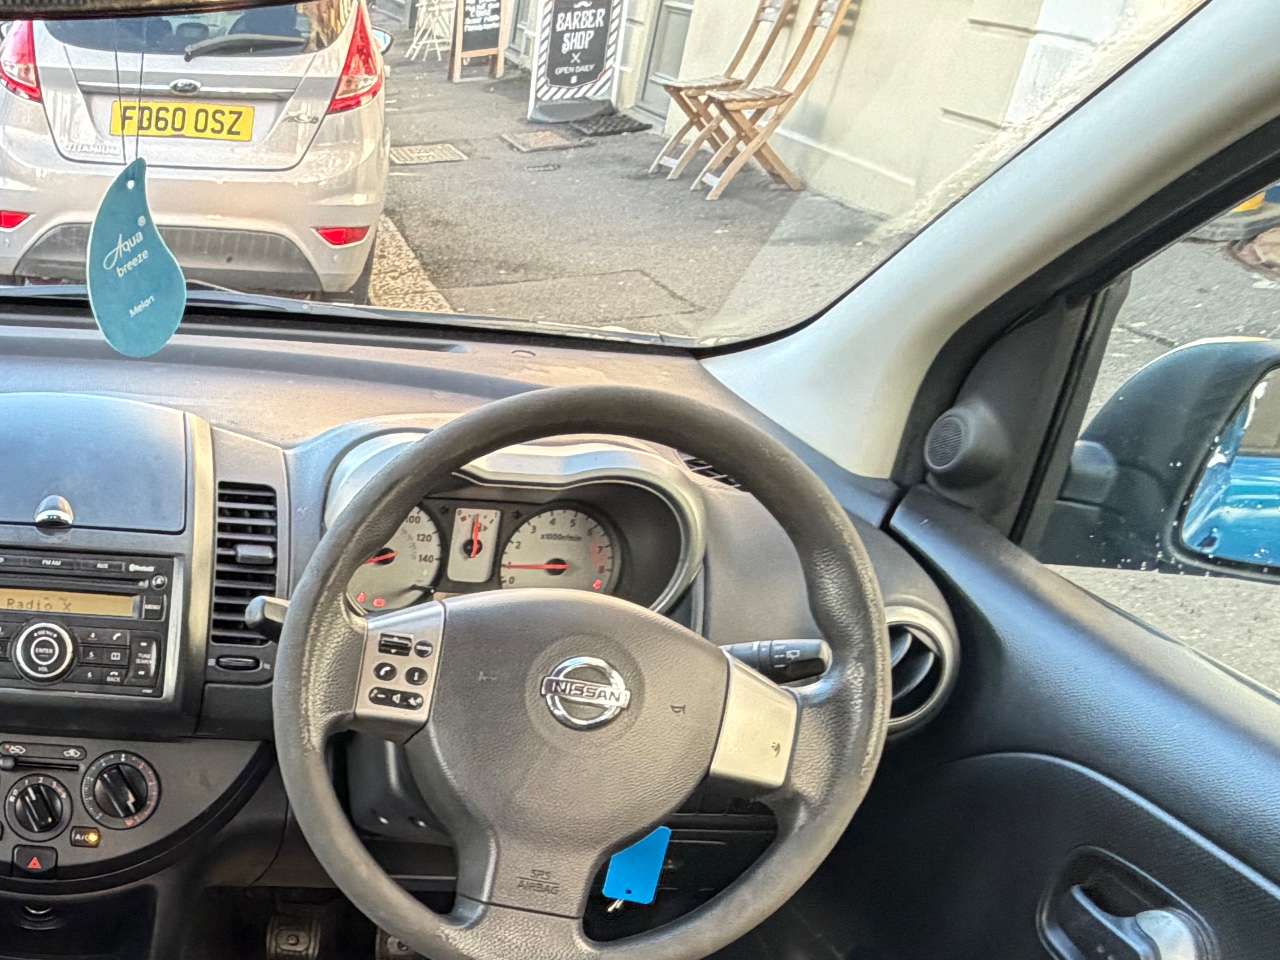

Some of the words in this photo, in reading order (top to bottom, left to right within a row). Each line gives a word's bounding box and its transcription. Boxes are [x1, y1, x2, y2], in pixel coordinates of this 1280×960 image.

[555, 8, 606, 32] BARBER
[561, 30, 595, 54] SHOP
[554, 65, 575, 75] OPEN
[121, 105, 187, 133] FD60
[194, 107, 244, 136] OSZ
[103, 231, 144, 270] Aqua
[116, 249, 150, 278] breeze
[416, 533, 433, 543] 120
[418, 554, 435, 564] 140
[551, 681, 622, 703] NISSAN
